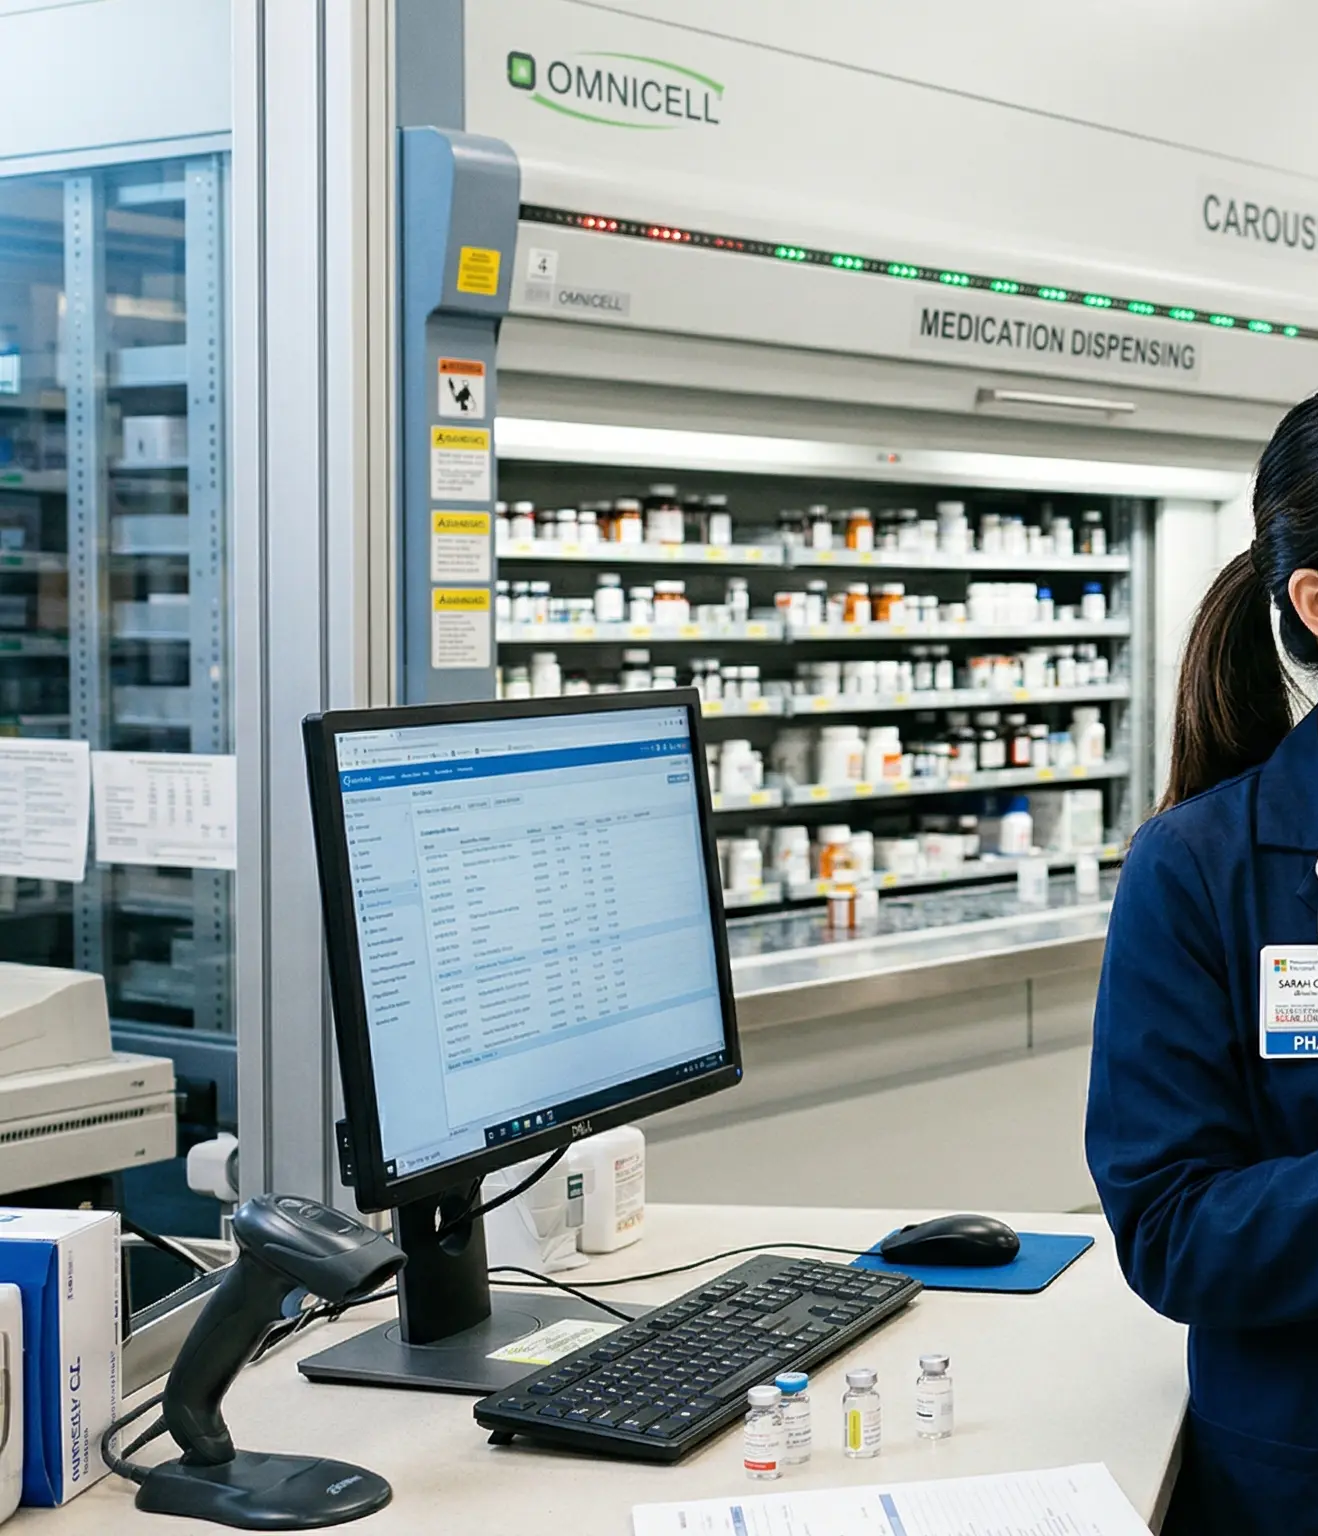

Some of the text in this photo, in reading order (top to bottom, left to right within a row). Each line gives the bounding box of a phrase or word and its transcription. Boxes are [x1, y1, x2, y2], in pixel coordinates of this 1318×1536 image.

[547, 61, 720, 125] OMNICELL
[558, 290, 623, 311] OMNICELL
[919, 307, 1196, 371] MEDICATION DISPENSING
[1278, 979, 1311, 990] SARAH
